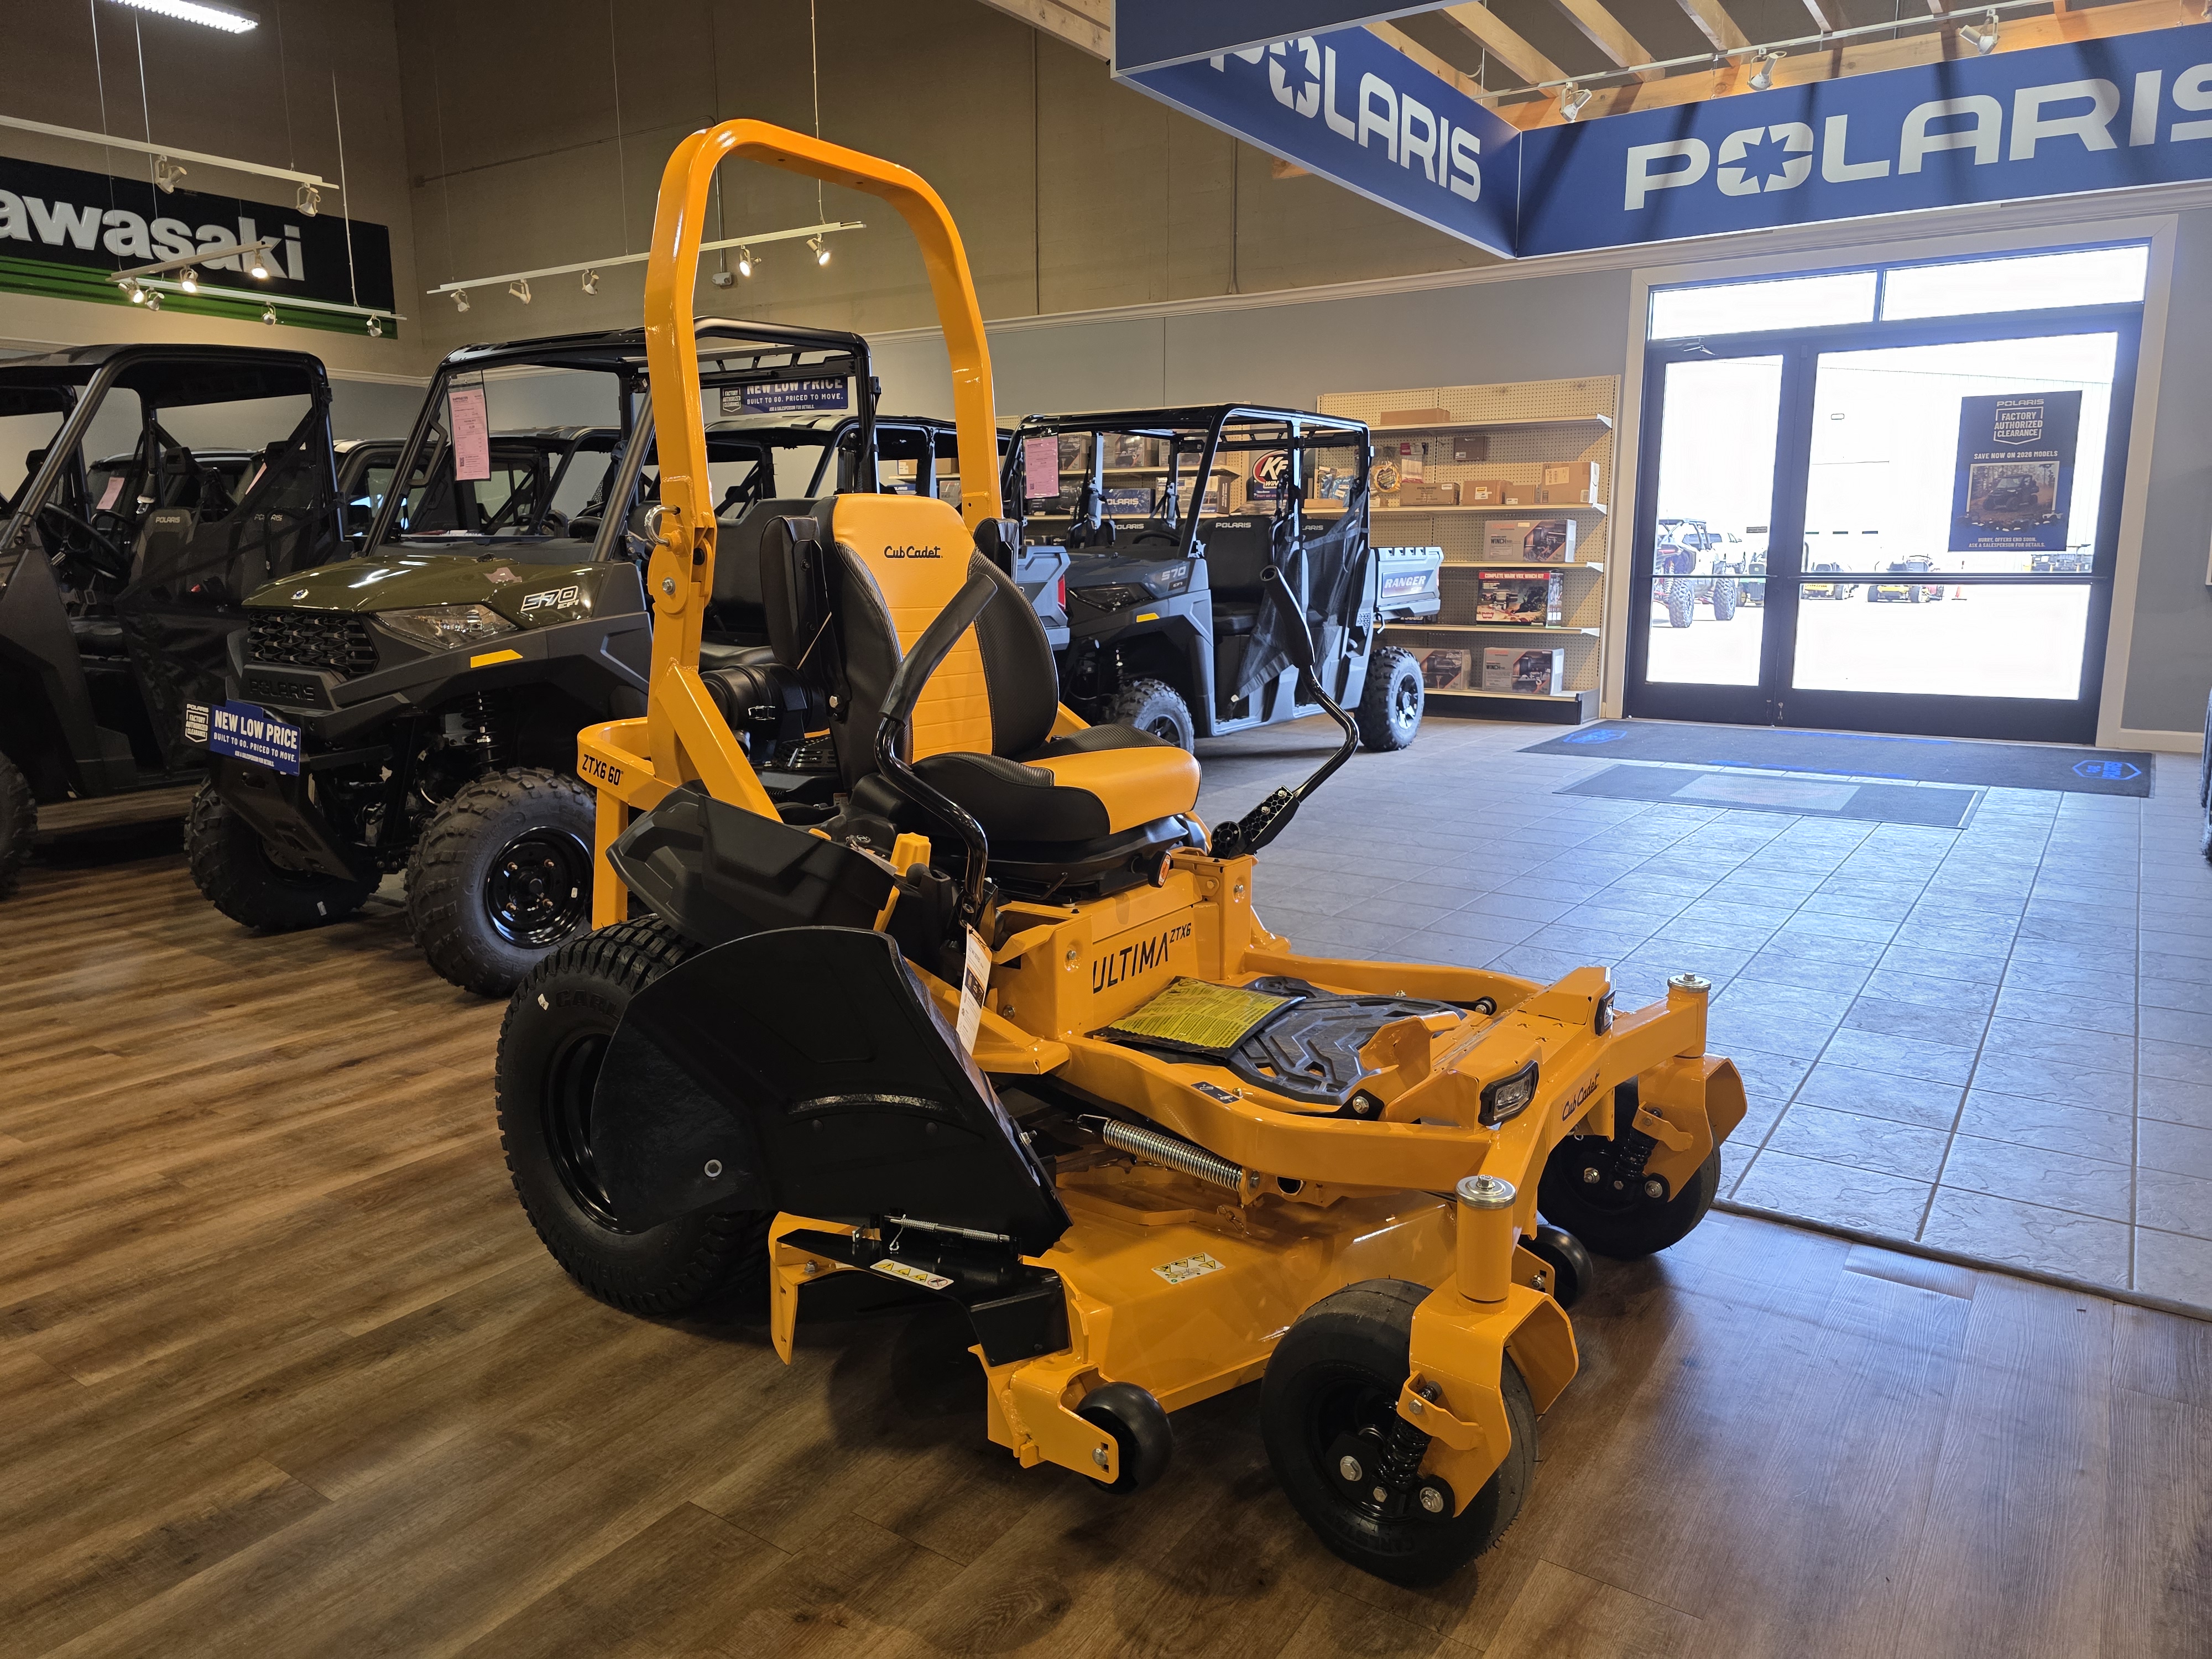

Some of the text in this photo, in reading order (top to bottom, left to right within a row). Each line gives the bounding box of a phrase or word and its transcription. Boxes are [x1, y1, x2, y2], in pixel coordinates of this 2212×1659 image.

[1210, 35, 1481, 202] OLARIS
[0, 190, 305, 281] awasaki
[1994, 420, 2043, 430] AUTHORIZED
[2002, 412, 2036, 420] FACTORY
[1260, 457, 1288, 479] KF
[884, 546, 941, 559] Cub Cadet
[1161, 566, 1186, 581] 570
[1385, 576, 1426, 588] RANGER
[520, 586, 578, 611] 570
[557, 599, 579, 609] EFI
[249, 679, 315, 701] POLARIS
[187, 704, 208, 713] POLARIS
[215, 710, 298, 749] NEW LOW PRICE
[214, 732, 229, 743] BUILT
[239, 739, 248, 748] GO.
[250, 742, 269, 754] PRICED
[272, 749, 278, 757] TO
[280, 751, 296, 763] MOVE.
[582, 753, 606, 779] ZTX6
[1093, 921, 1192, 994] ULTIMA ZTX6
[1562, 1072, 1600, 1122] Cub Cadet
